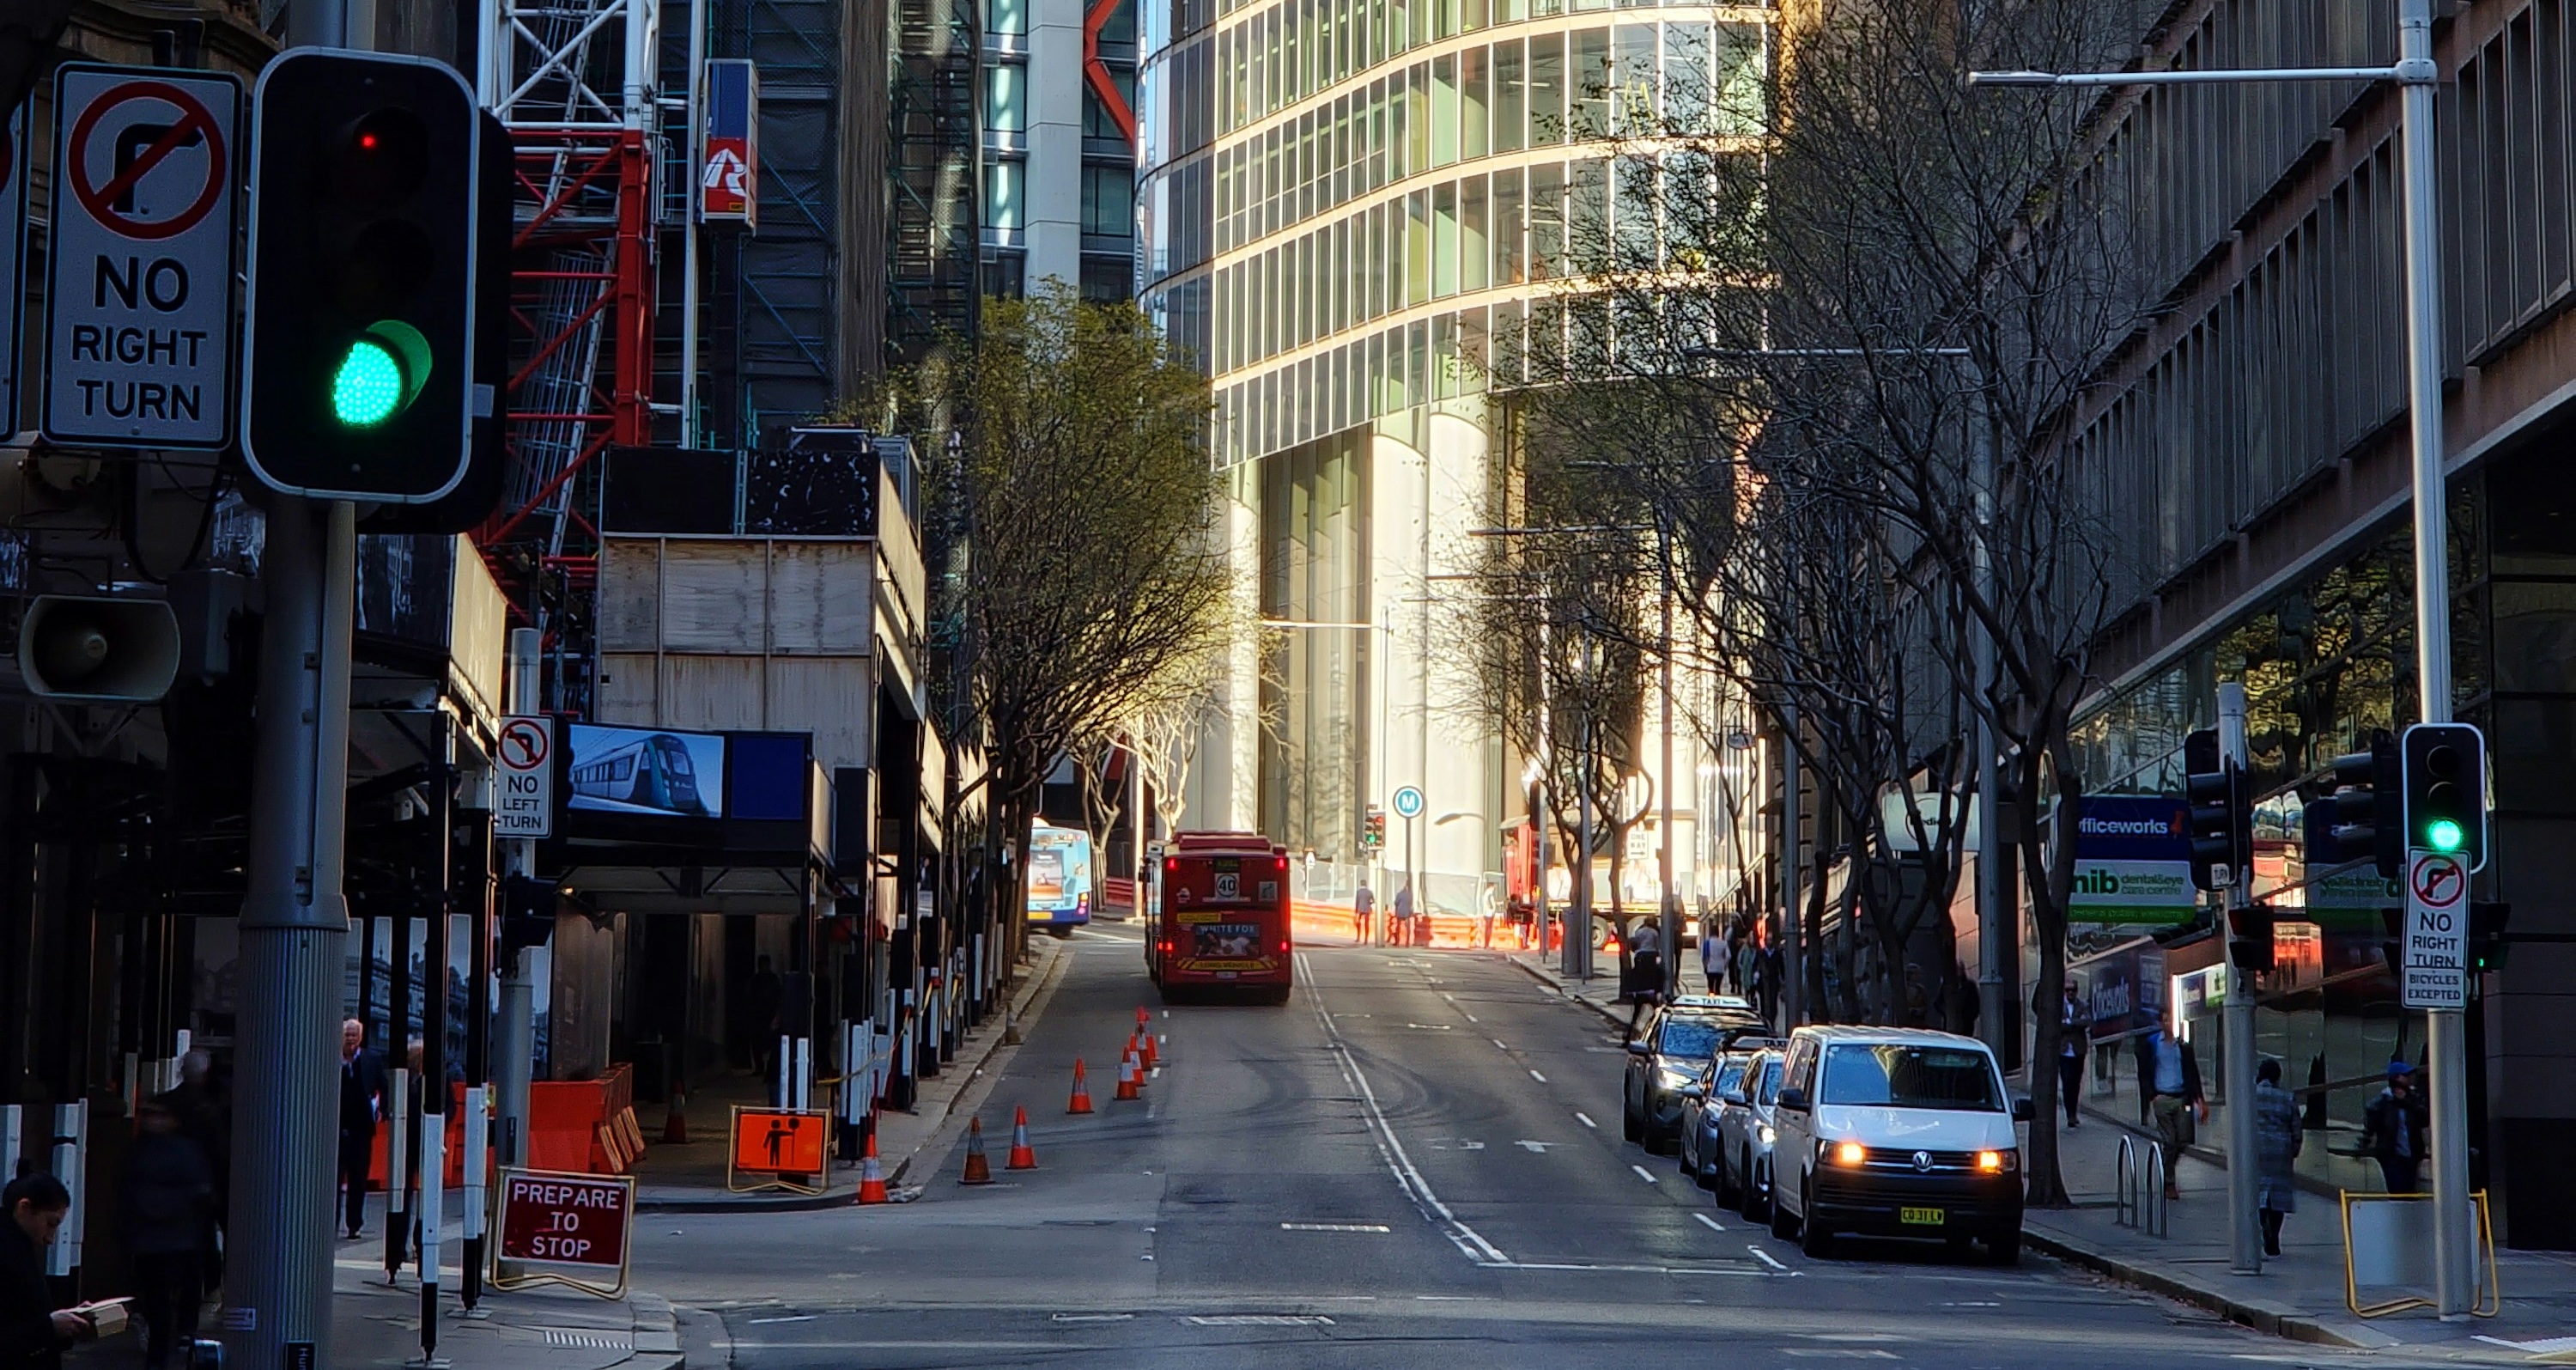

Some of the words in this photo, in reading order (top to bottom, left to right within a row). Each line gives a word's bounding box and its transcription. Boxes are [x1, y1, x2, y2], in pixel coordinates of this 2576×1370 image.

[95, 256, 189, 313] NO
[71, 325, 207, 367] RIGHT
[76, 379, 200, 421] TURN
[507, 776, 538, 794] NO
[503, 798, 540, 812] LEFT
[1401, 794, 1416, 810] M
[502, 815, 542, 829] TURN
[1218, 879, 1236, 892] 40
[2072, 868, 2119, 894] nib
[1200, 924, 1233, 934] WHITE
[1235, 924, 1255, 933] FOX
[2420, 911, 2452, 932] NO
[2412, 935, 2458, 951] RIGHT
[2414, 953, 2456, 967] TURN
[2409, 974, 2459, 986] BICYCLES
[2408, 988, 2461, 1000] EXCEPTED
[1765, 1039, 1788, 1048] TAXI
[513, 1183, 620, 1209] PREPARE
[550, 1211, 580, 1232] TO
[532, 1235, 592, 1258] STOP
